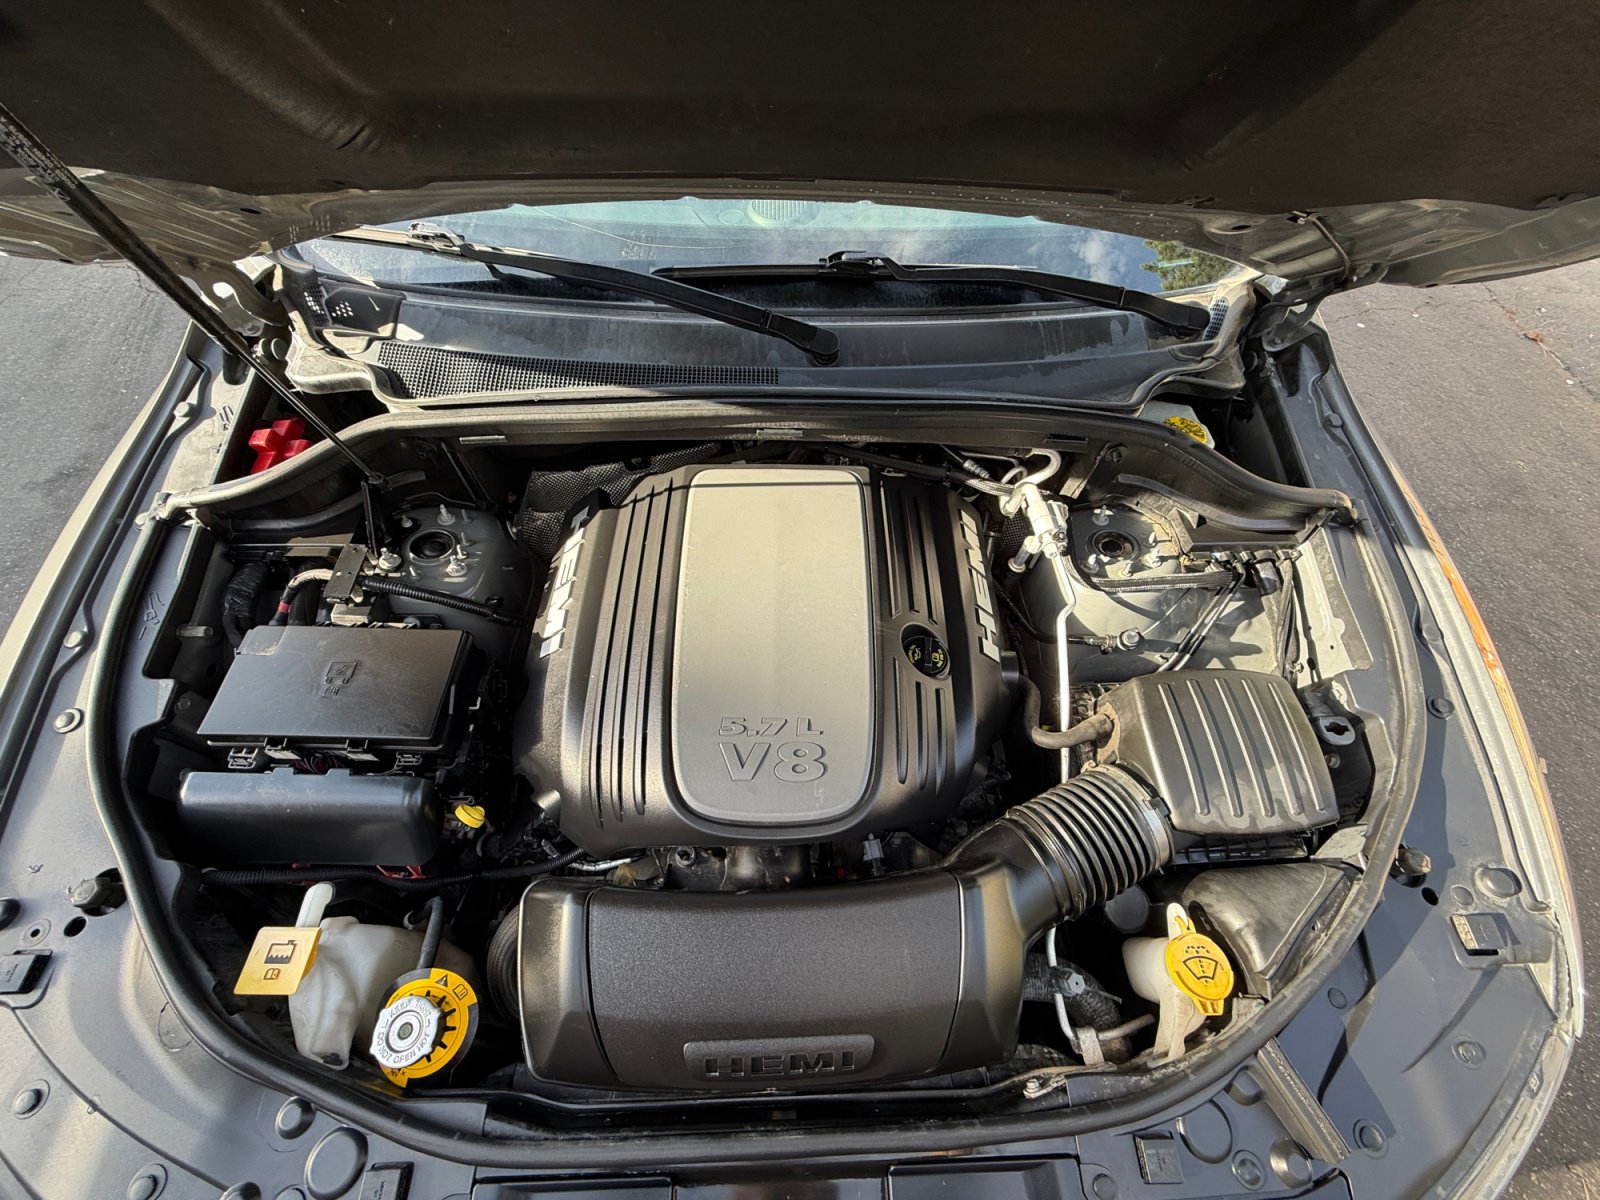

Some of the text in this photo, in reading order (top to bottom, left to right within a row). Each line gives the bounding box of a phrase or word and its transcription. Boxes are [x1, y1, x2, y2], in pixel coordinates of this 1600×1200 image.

[539, 505, 590, 659] HEMI
[960, 509, 1000, 663] HEMI
[718, 741, 828, 783] V8
[389, 1000, 432, 1017] KEEP TIGHT
[378, 1045, 393, 1061] NOT
[393, 1050, 415, 1063] OPEN
[417, 1031, 430, 1051] HOT
[704, 1051, 855, 1077] HEMI
